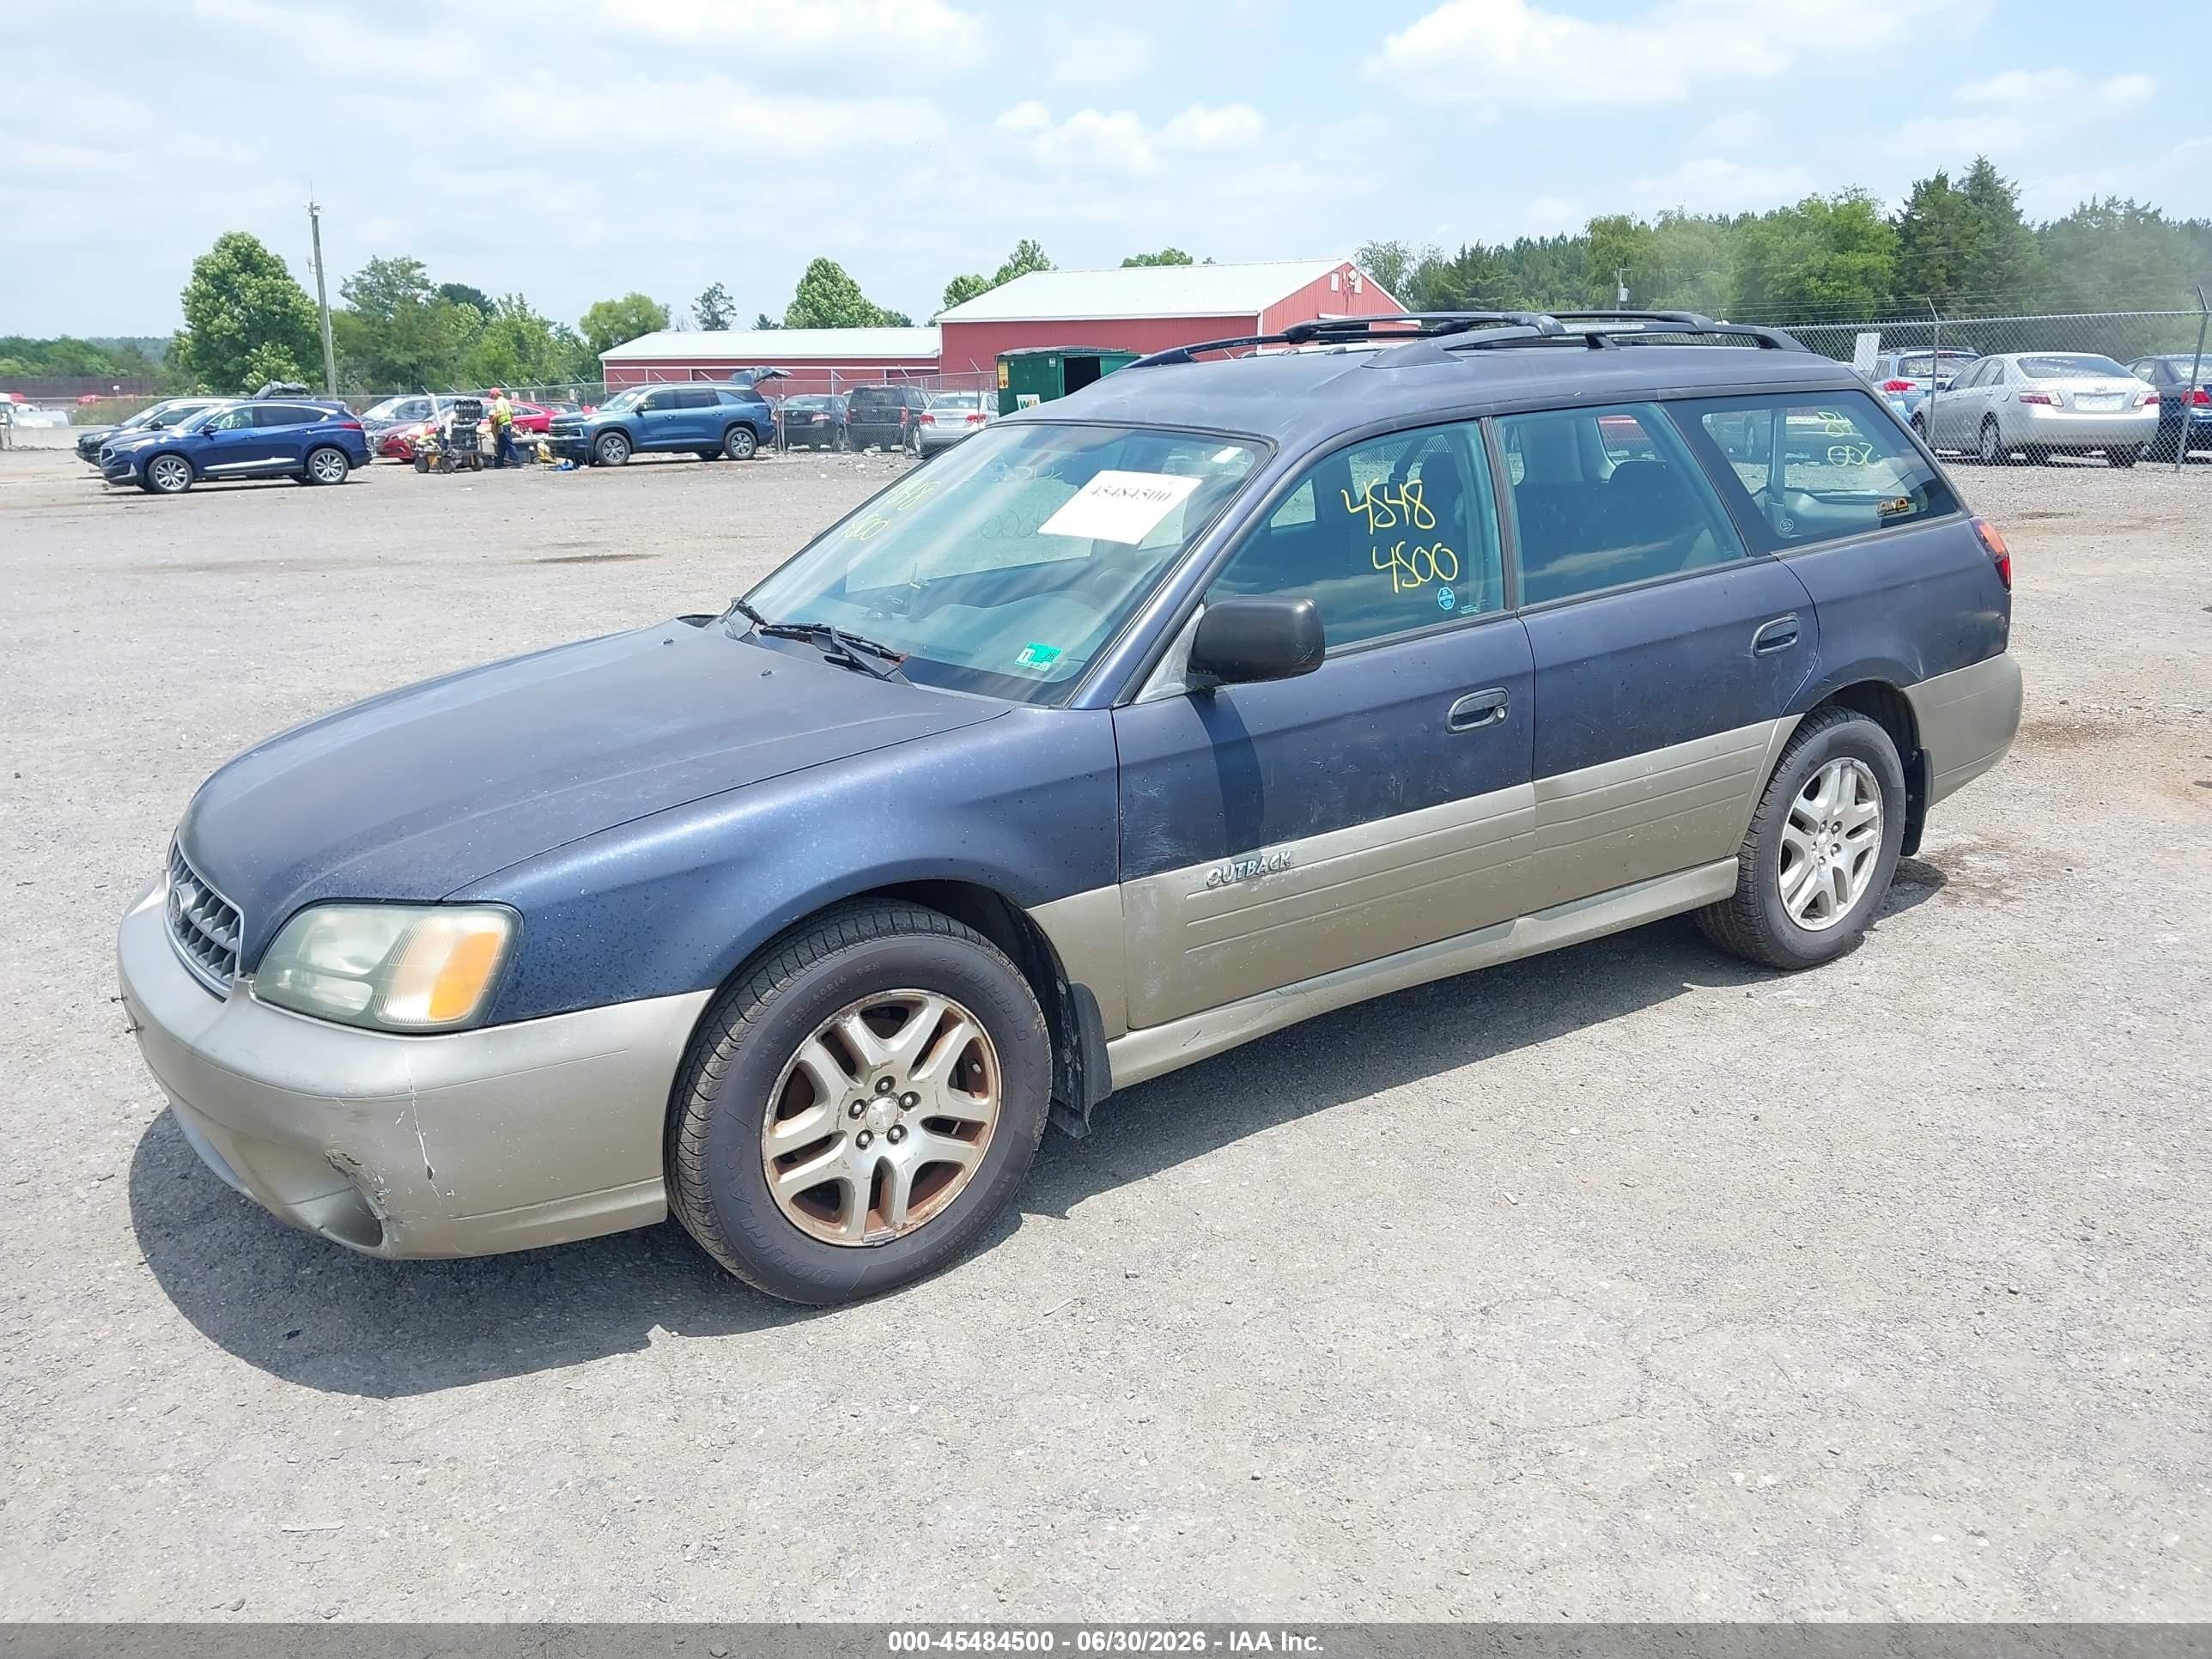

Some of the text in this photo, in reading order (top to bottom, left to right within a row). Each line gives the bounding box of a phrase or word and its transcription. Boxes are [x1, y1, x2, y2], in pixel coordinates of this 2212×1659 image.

[1090, 485, 1173, 502] 45484500
[1340, 477, 1437, 535] 4548
[1372, 541, 1459, 593] 4500
[1206, 851, 1291, 887] OUTBACK
[725, 1145, 842, 1286] DOUGLAS
